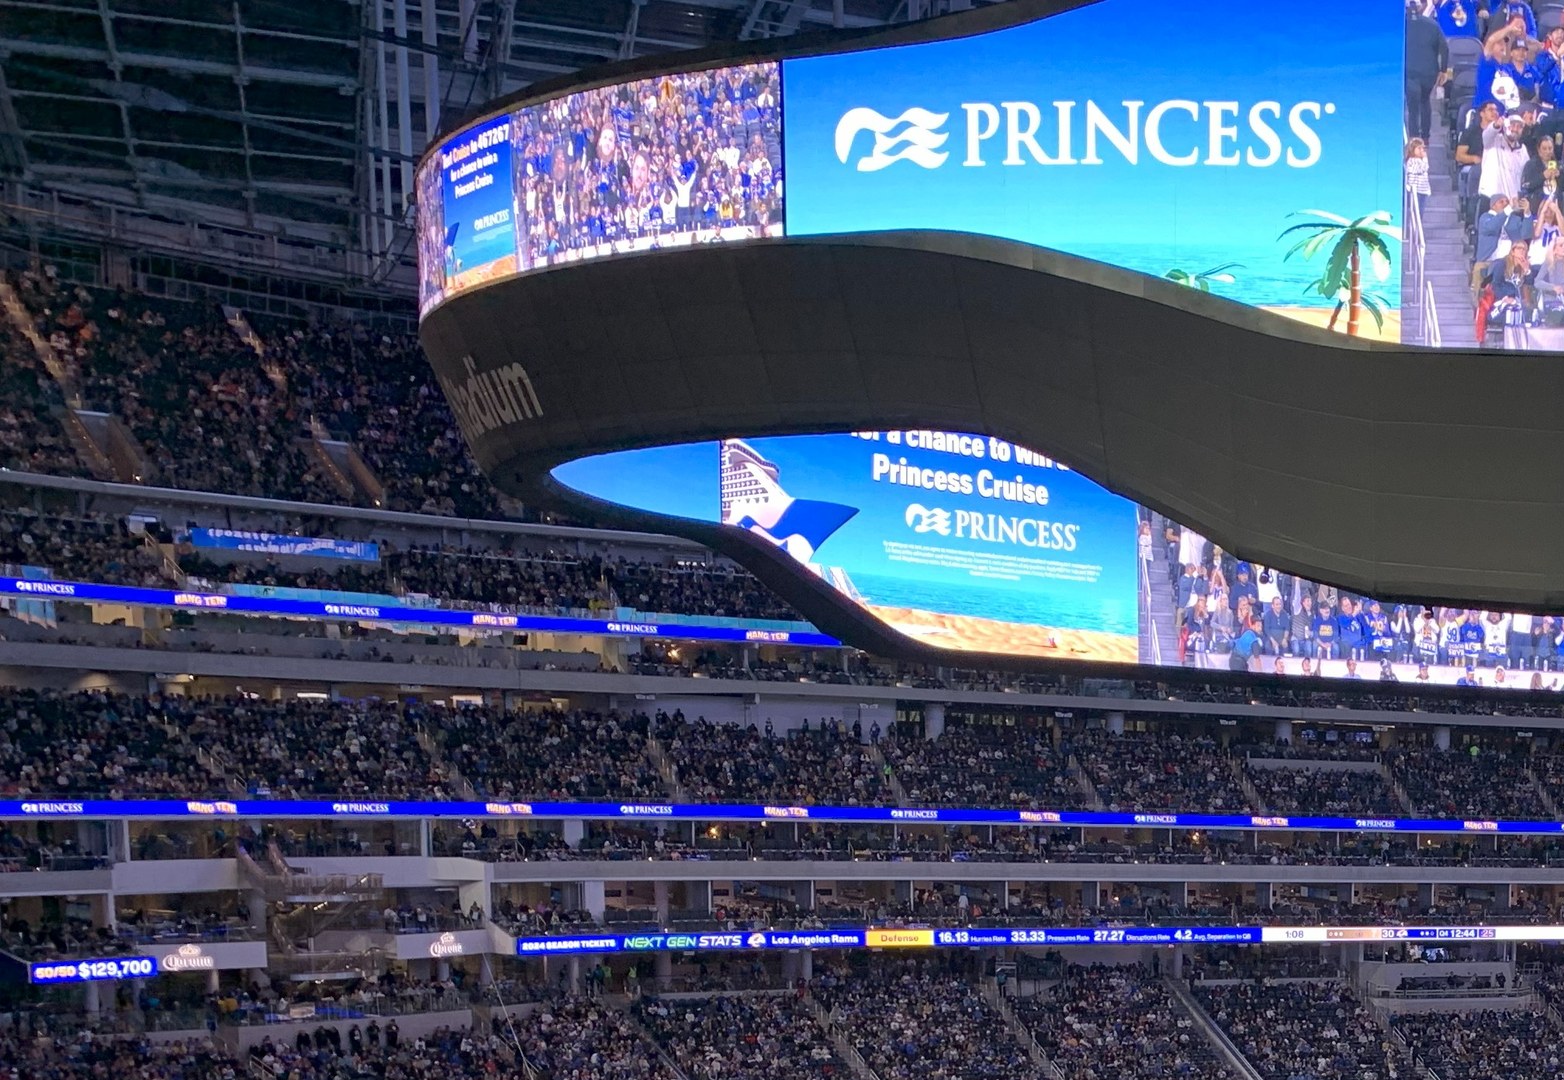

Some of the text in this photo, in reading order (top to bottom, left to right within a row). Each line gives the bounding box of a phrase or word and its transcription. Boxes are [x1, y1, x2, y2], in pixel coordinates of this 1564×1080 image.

[961, 99, 1327, 169] PRINCESS
[989, 436, 1011, 462] to
[873, 453, 1049, 506] Princess Cruise
[954, 511, 1078, 552] PRINCESS
[31, 583, 74, 594] PRINCESS
[175, 594, 203, 605] HANG
[340, 605, 380, 616] PRINCESS
[473, 615, 497, 625] HANG
[620, 623, 658, 634] PRINCESS
[39, 803, 82, 812] PRINCESS
[187, 802, 216, 813] HANG
[347, 804, 389, 812] PRINCESS
[486, 803, 511, 814] HANG
[635, 806, 673, 815] PRINCESS
[764, 807, 788, 817] HANG
[904, 810, 937, 818] PRINCESS
[1147, 815, 1176, 823] PRINCESS
[880, 934, 919, 943] Defense
[937, 931, 969, 944] 16.13
[1010, 930, 1046, 942] 33.33
[1093, 930, 1125, 942] 27.27
[1174, 930, 1192, 941] 4.2
[1285, 930, 1304, 939] 1:08
[1382, 930, 1395, 938] 30
[1450, 930, 1475, 938] 12:44
[623, 935, 742, 949] NEXT GEN STATS
[771, 934, 858, 946] Los Angeles Rams
[78, 959, 152, 981] $129,700
